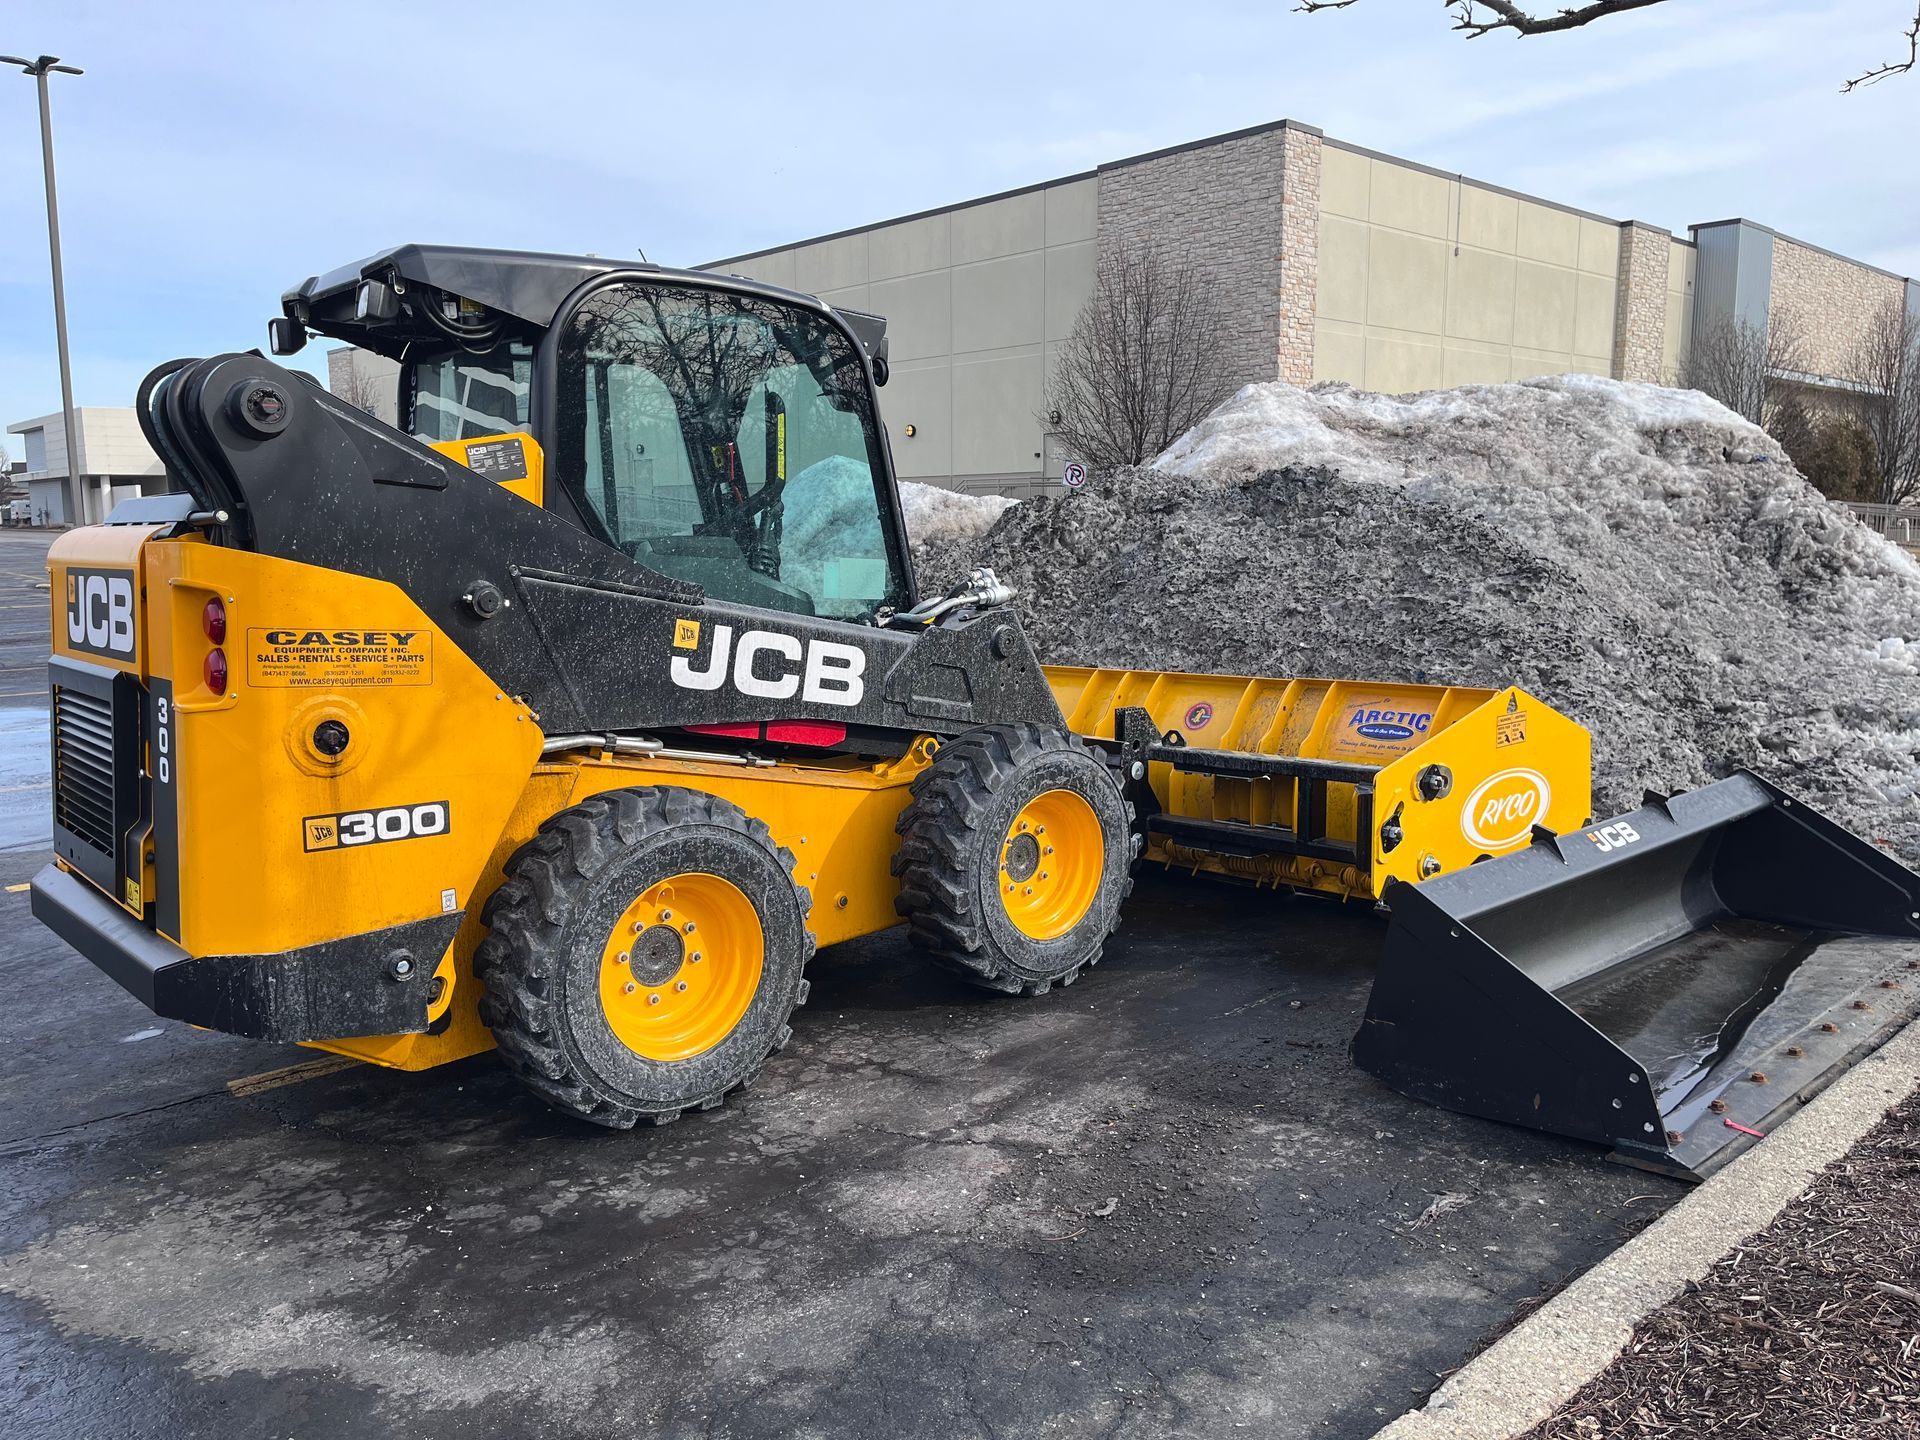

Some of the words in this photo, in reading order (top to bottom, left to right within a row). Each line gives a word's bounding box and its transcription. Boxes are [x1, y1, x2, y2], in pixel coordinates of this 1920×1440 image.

[467, 446, 487, 455] JCB
[68, 575, 134, 653] JCB
[266, 631, 417, 646] CASEY
[681, 627, 695, 640] JCB
[257, 654, 290, 662] SALES
[299, 654, 341, 662] RENTALS
[350, 654, 388, 662] SERVICE
[397, 654, 425, 662] PARTS
[670, 624, 866, 707] JCB
[289, 676, 393, 686] www.caseyequipment.com
[1348, 709, 1432, 733] ARCTIC
[158, 697, 170, 784] 300
[1479, 789, 1536, 829] RYCO
[314, 825, 333, 841] JCB
[340, 804, 445, 845] 300
[1594, 821, 1641, 852] JCB
